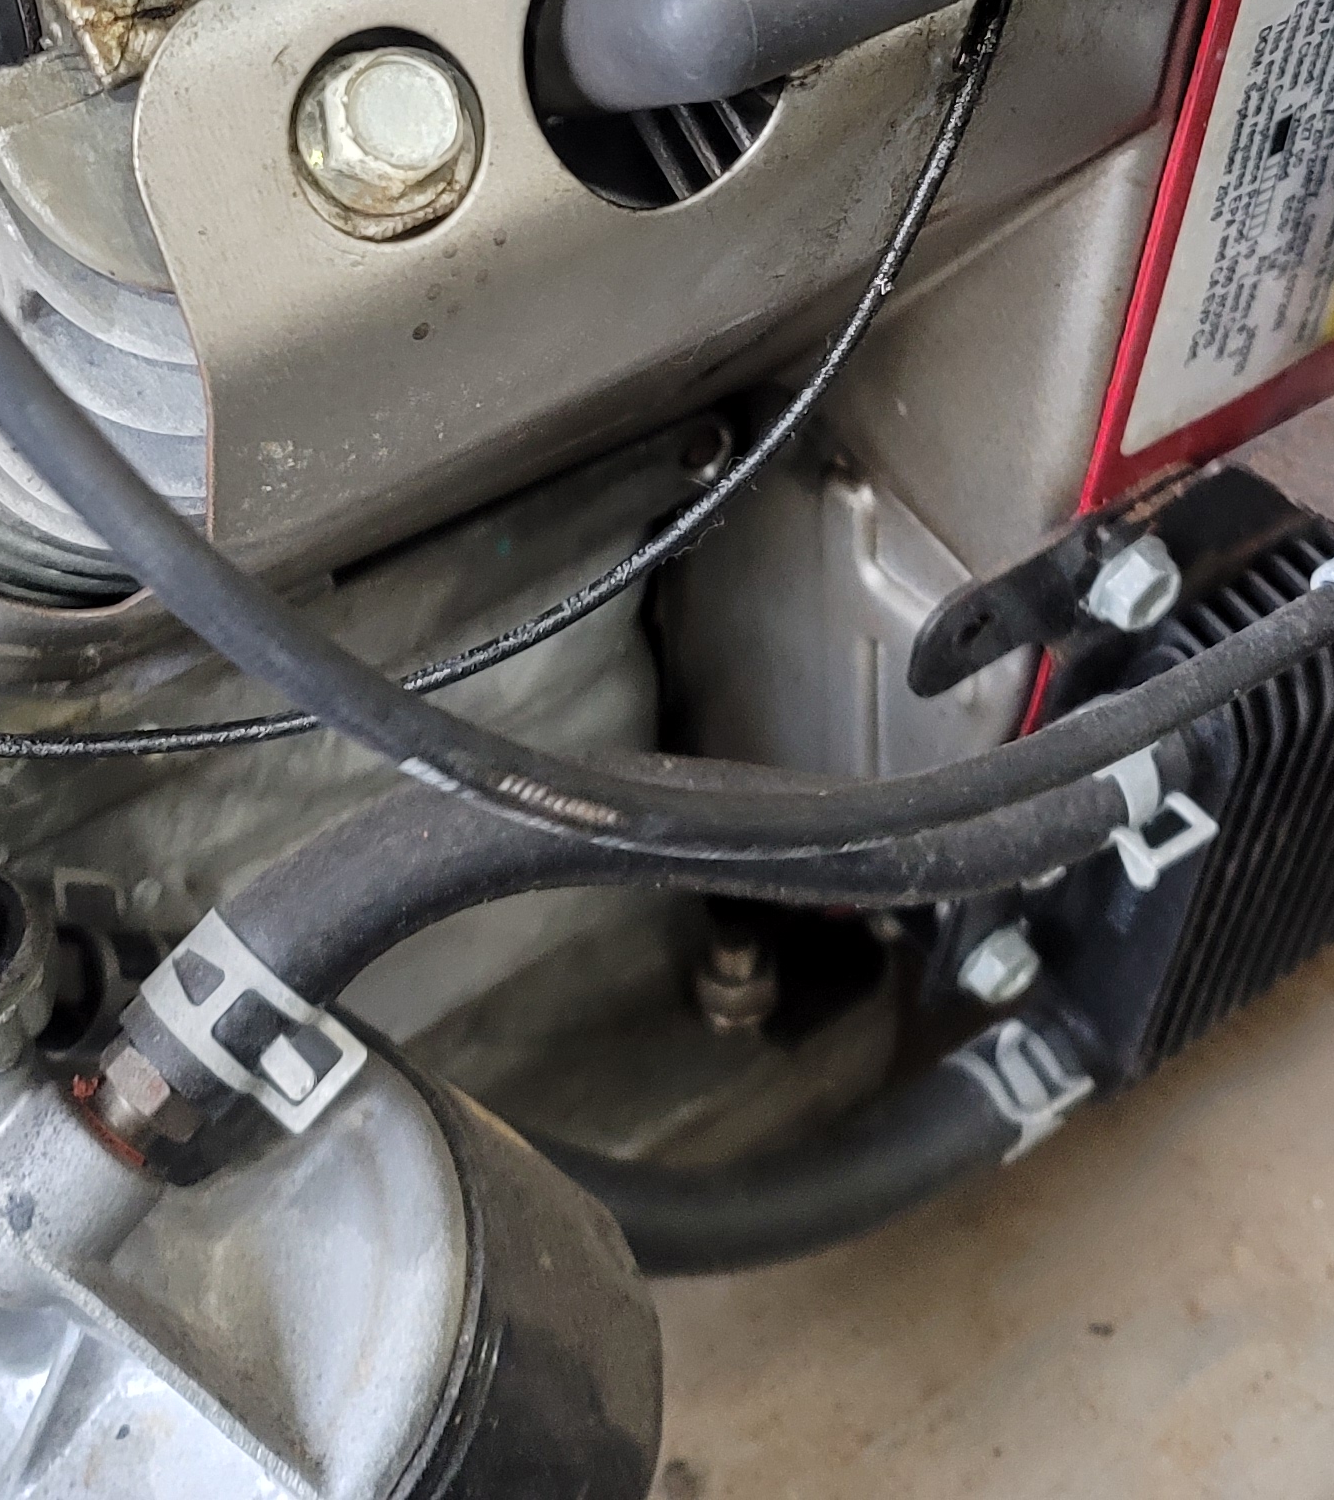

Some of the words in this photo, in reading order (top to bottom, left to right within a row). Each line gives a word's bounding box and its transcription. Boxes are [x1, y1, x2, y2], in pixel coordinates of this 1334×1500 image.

[1267, 14, 1291, 56] This
[1249, 57, 1277, 120] engine
[1285, 38, 1313, 93] Clean
[1220, 80, 1257, 179] September
[1230, 120, 1259, 193] requires
[1221, 192, 1243, 232] EPA
[1213, 232, 1231, 265] and
[1206, 263, 1225, 292] CA
